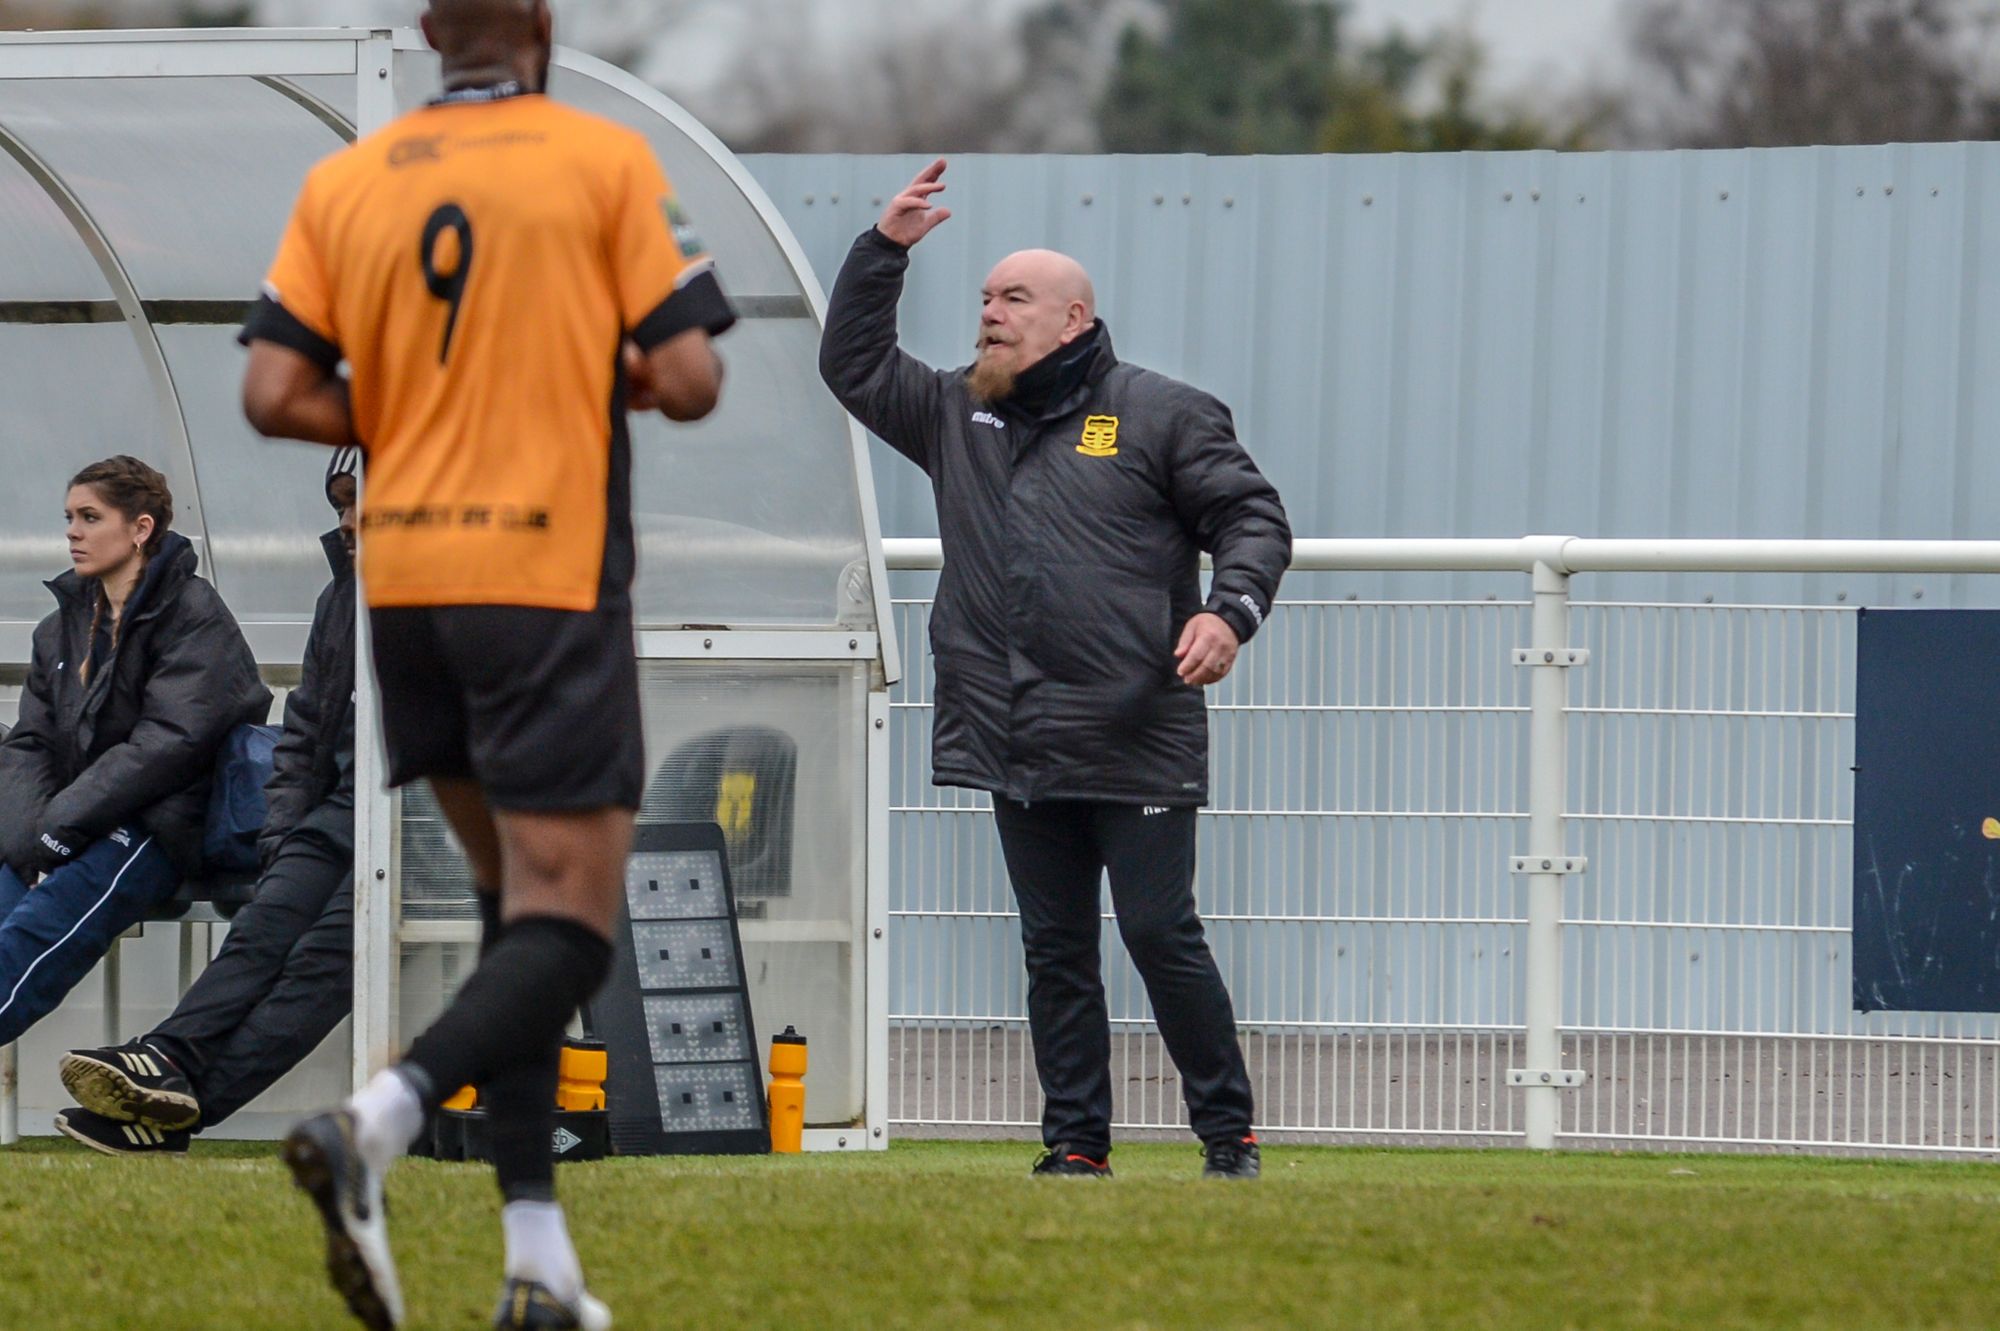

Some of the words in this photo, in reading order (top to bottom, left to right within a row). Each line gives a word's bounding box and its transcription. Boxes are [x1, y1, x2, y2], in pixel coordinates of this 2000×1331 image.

[421, 203, 474, 365] 9
[971, 411, 1004, 428] mitre
[40, 833, 71, 856] mitre
